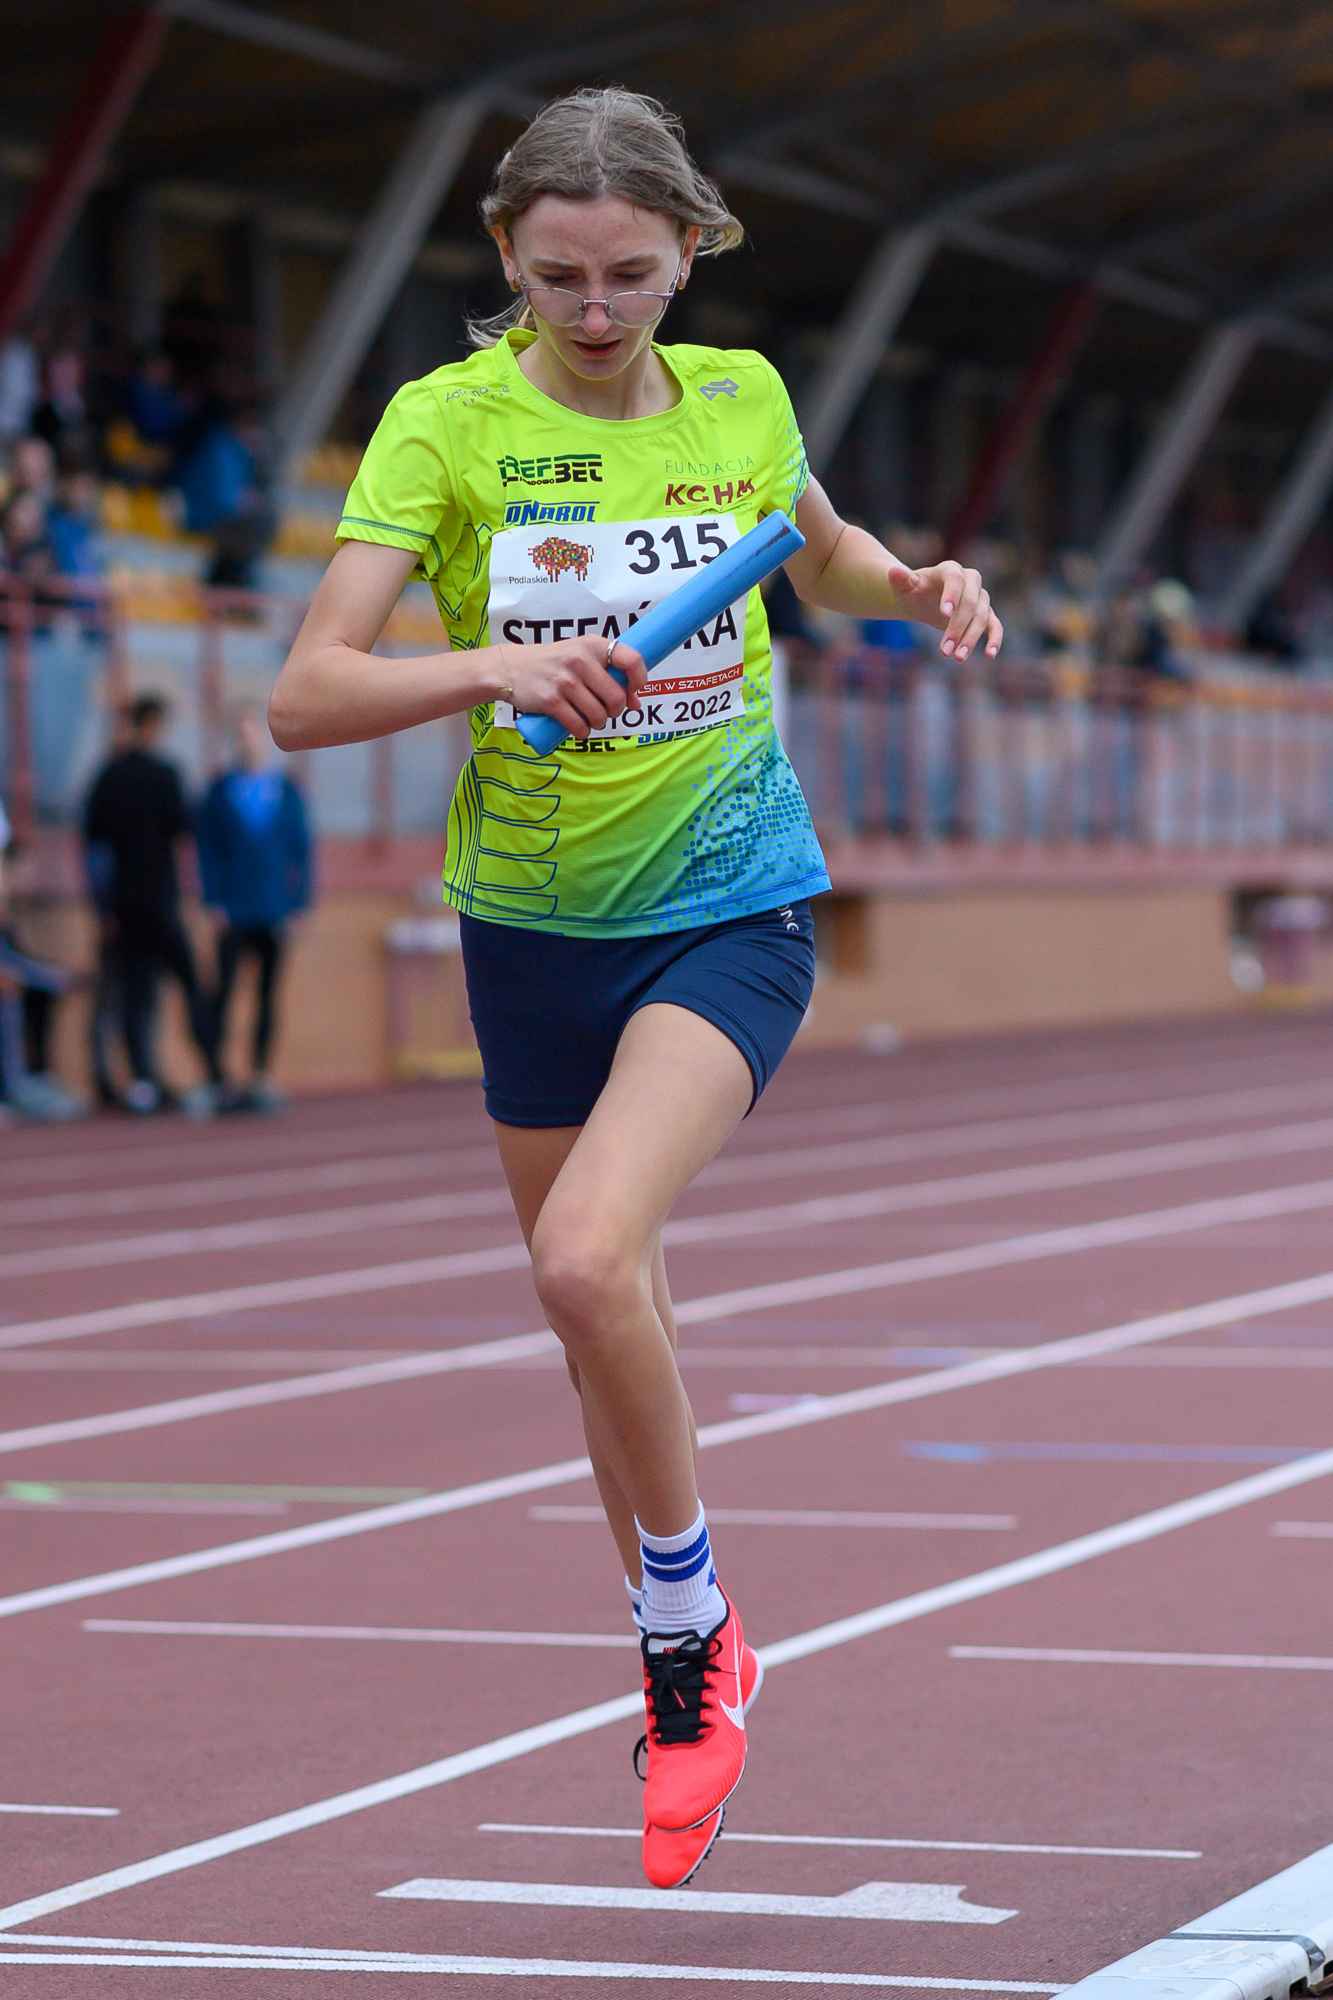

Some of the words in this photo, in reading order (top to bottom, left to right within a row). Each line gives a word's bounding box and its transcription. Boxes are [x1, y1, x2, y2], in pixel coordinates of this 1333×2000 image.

[665, 456, 755, 476] FUNDACJA
[503, 500, 596, 526] ONAROL
[624, 522, 729, 575] 315
[509, 575, 548, 584] Podlaskie
[664, 681, 676, 691] W
[678, 668, 740, 690] SZTAFETACH
[673, 690, 732, 723] 2022
